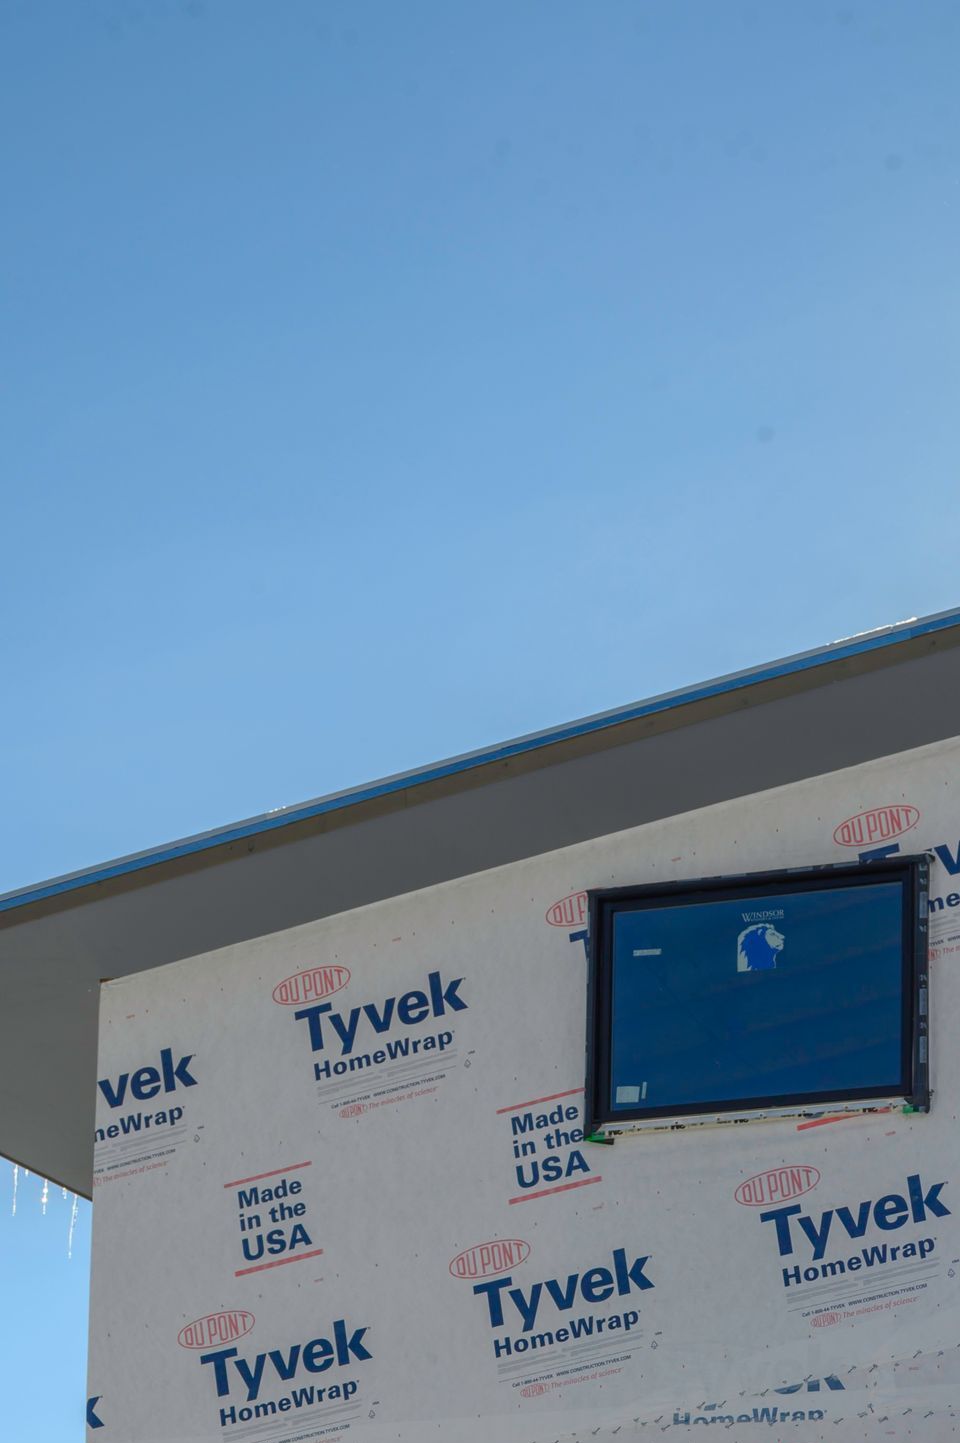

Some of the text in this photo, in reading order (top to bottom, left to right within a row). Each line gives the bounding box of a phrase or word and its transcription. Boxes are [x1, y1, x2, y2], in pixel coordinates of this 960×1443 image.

[741, 909, 784, 923] WINDSOR
[295, 971, 468, 1055] Tyvek
[98, 1048, 198, 1108] vek
[313, 1032, 453, 1081] HomeWrap
[510, 1104, 580, 1135] Made
[513, 1126, 584, 1159] in the
[237, 1178, 302, 1208] Made
[516, 1151, 590, 1189] USA
[240, 1200, 307, 1232] in the
[760, 1174, 952, 1260] Tyvek
[242, 1224, 312, 1261] USA
[782, 1239, 935, 1287] HomeWrap
[474, 1248, 655, 1332] Tyvek
[493, 1311, 639, 1358] HomeWrap
[200, 1320, 373, 1401] Tyvek
[219, 1381, 357, 1426] HomeWrap
